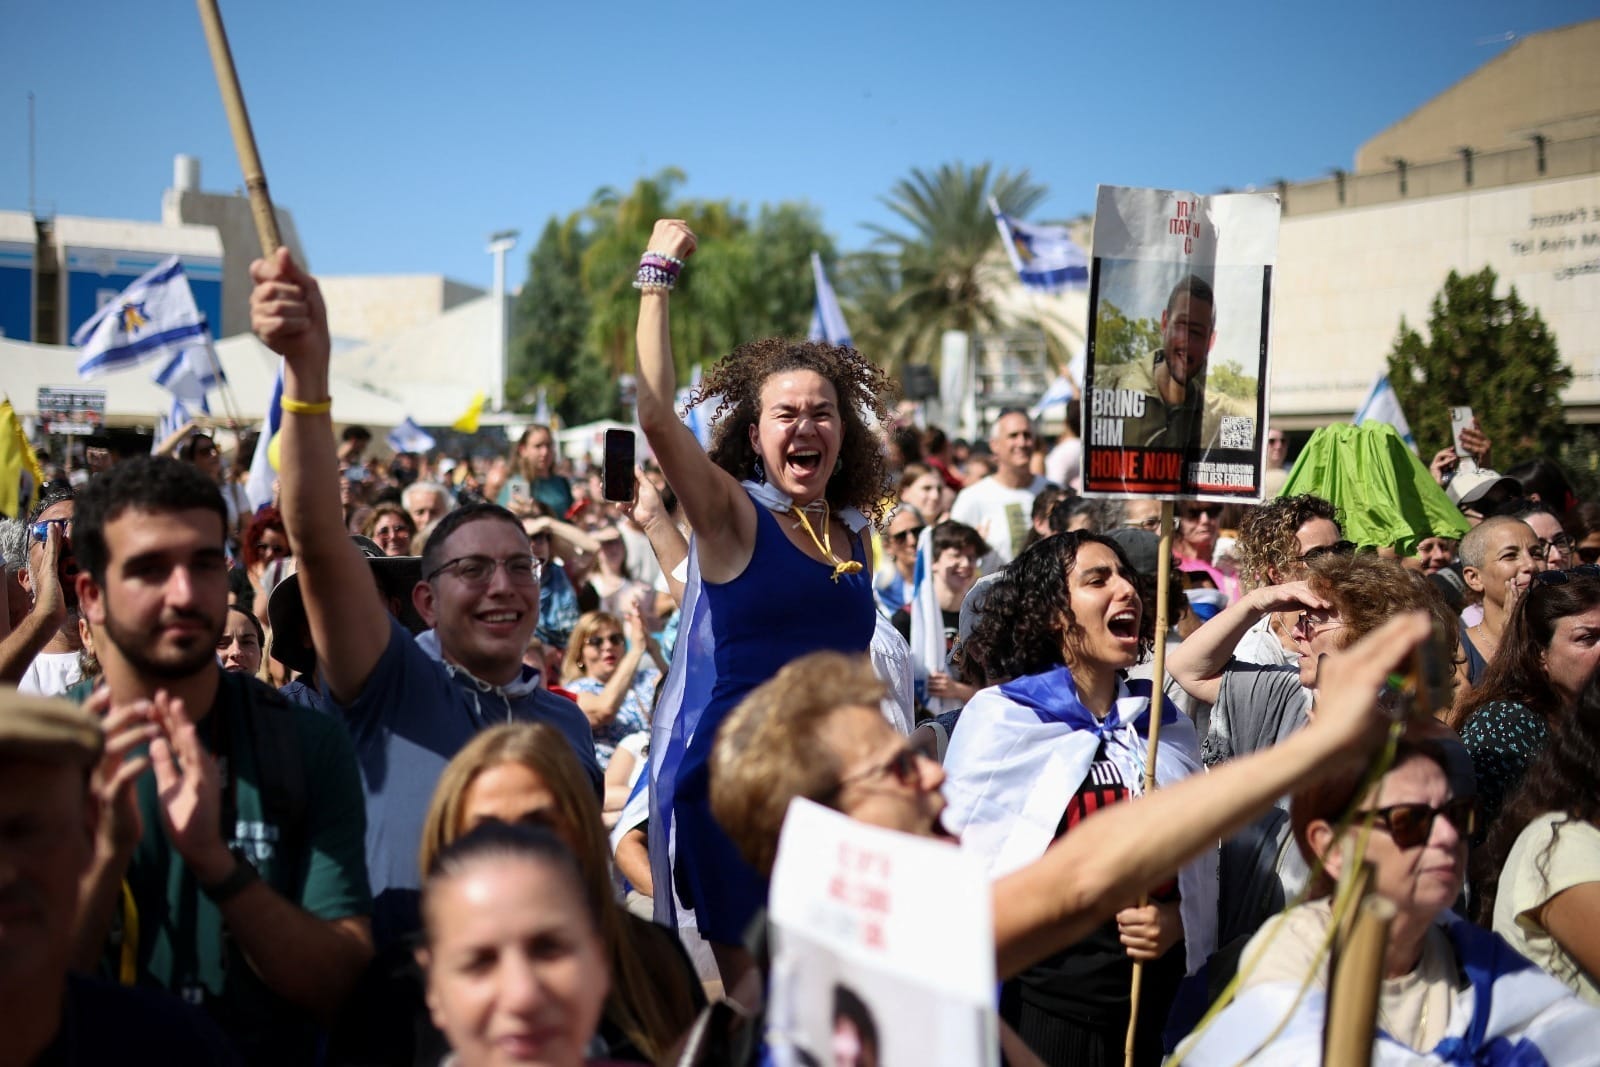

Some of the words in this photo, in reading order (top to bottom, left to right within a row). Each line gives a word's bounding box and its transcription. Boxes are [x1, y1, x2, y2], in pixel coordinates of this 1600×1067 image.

[1169, 218, 1191, 235] ITAY
[1091, 388, 1146, 418] BRING
[1091, 417, 1124, 446] HIM
[1090, 449, 1139, 480] HOME
[1223, 473, 1254, 489] FORUM
